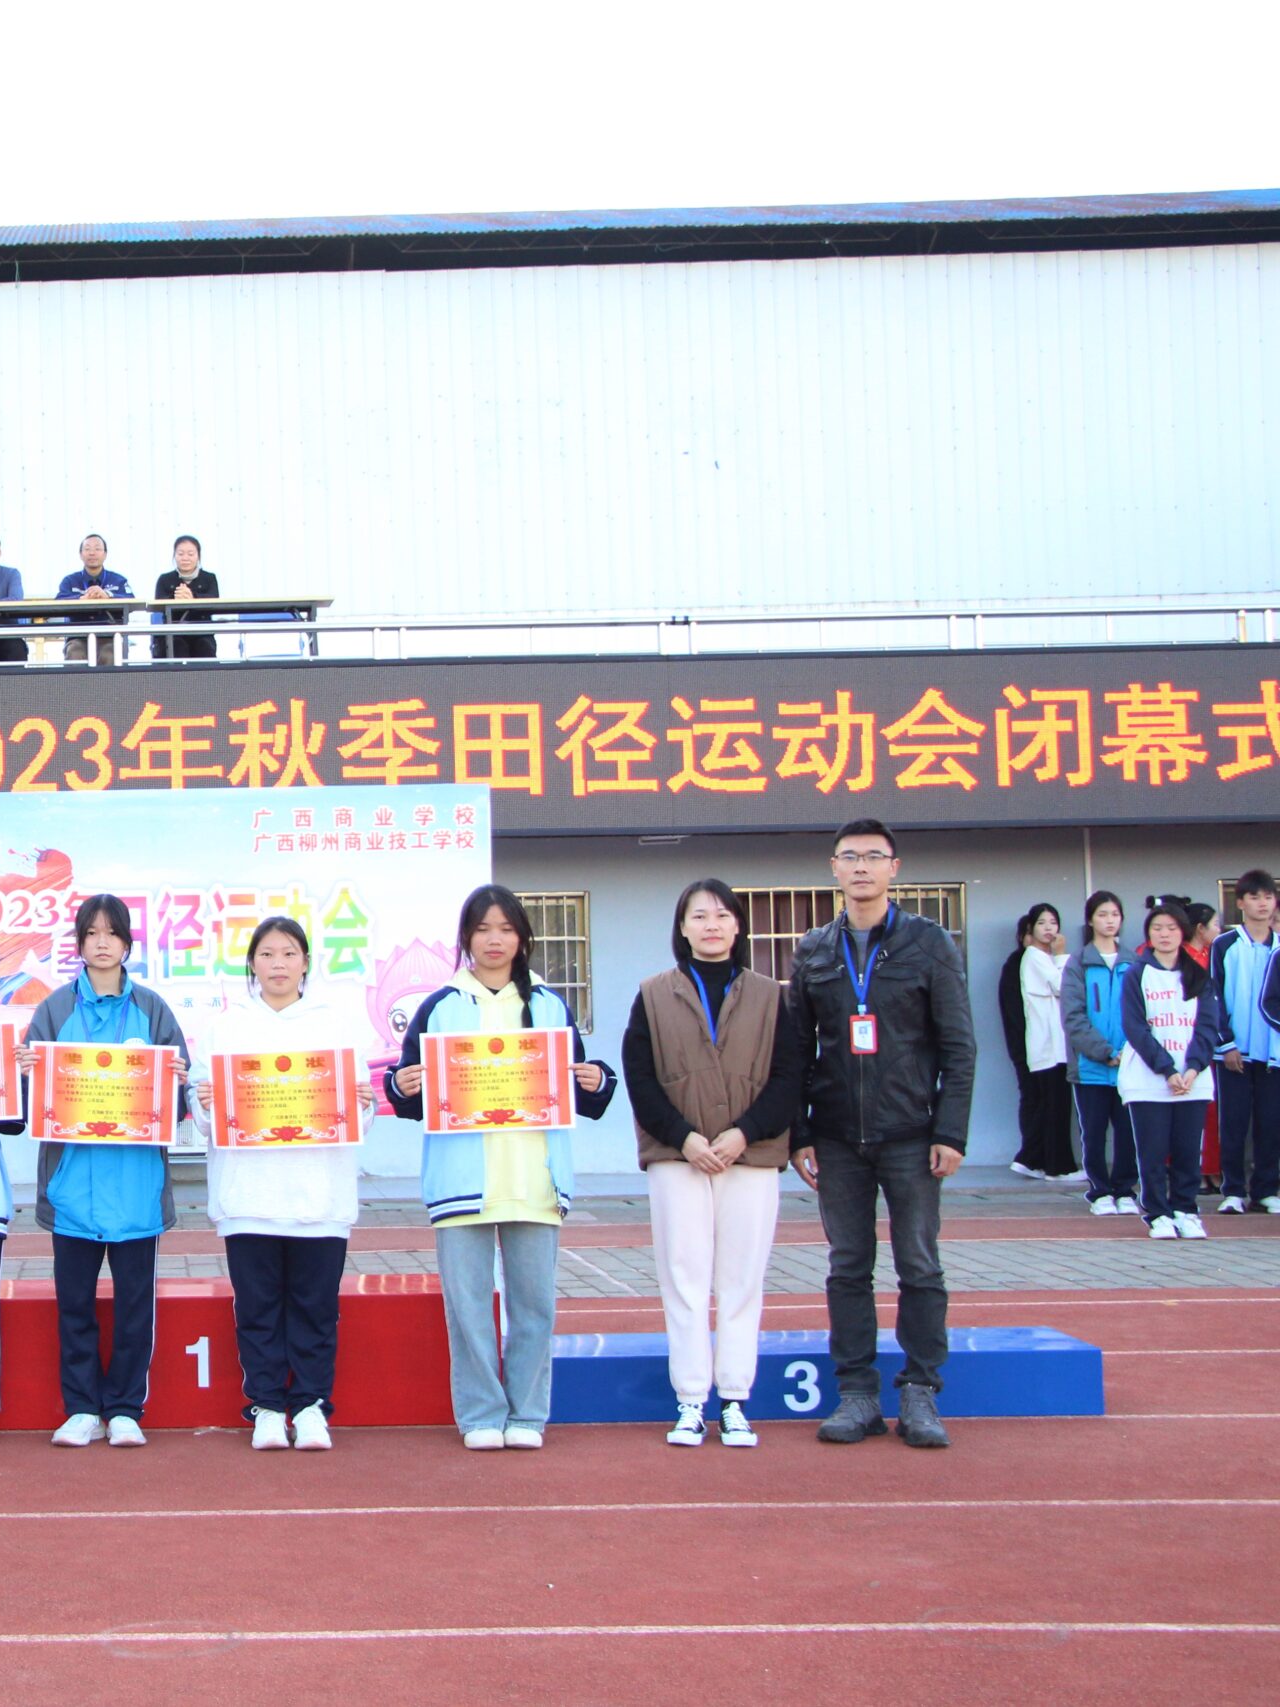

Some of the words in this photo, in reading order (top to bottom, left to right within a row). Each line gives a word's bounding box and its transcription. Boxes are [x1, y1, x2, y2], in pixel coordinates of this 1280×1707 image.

[252, 807, 475, 829] 广西商业学校
[253, 831, 475, 852] 广西柳州商业技工学校
[185, 1336, 210, 1388] 1
[783, 1360, 821, 1412] 3
